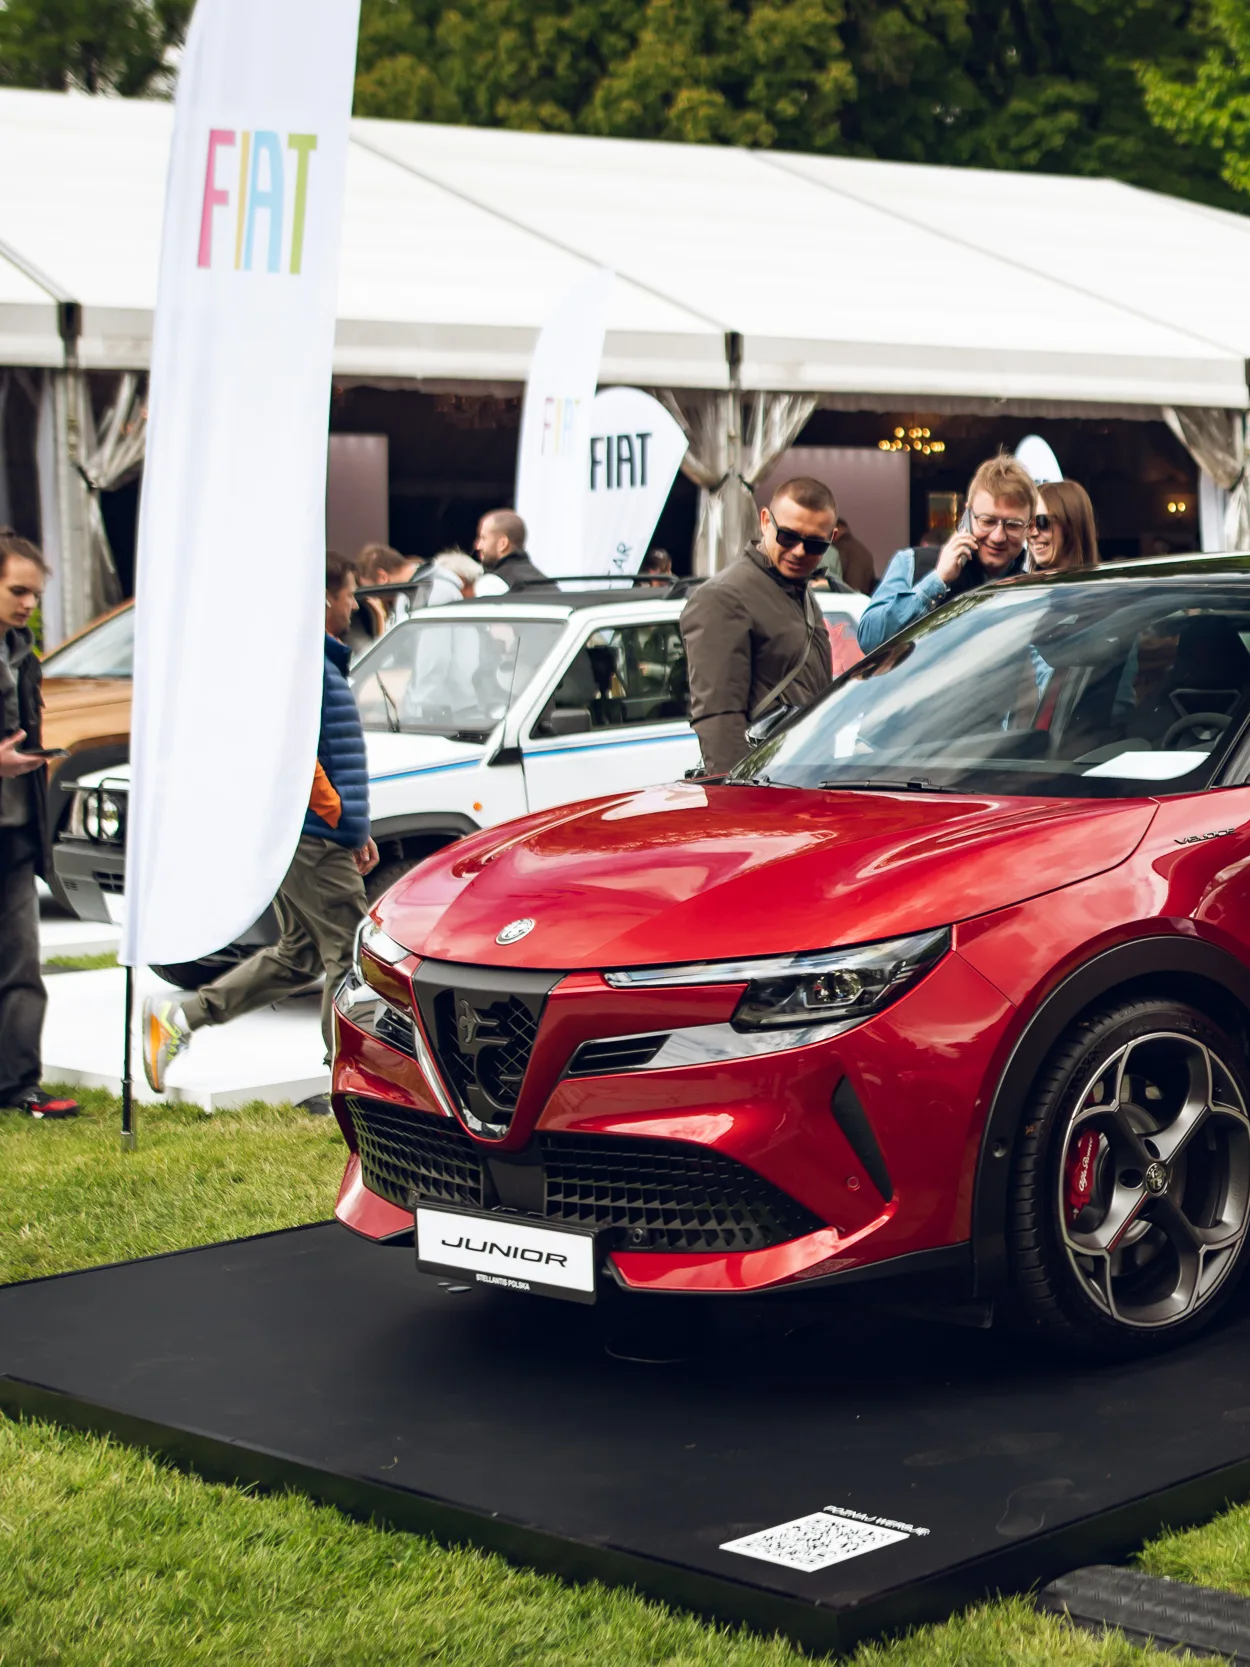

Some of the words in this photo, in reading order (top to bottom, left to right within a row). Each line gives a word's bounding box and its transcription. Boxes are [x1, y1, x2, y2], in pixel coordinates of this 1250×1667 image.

[197, 128, 318, 275] FIAT
[590, 432, 652, 490] FIAT
[441, 1237, 568, 1268] JUNIOR
